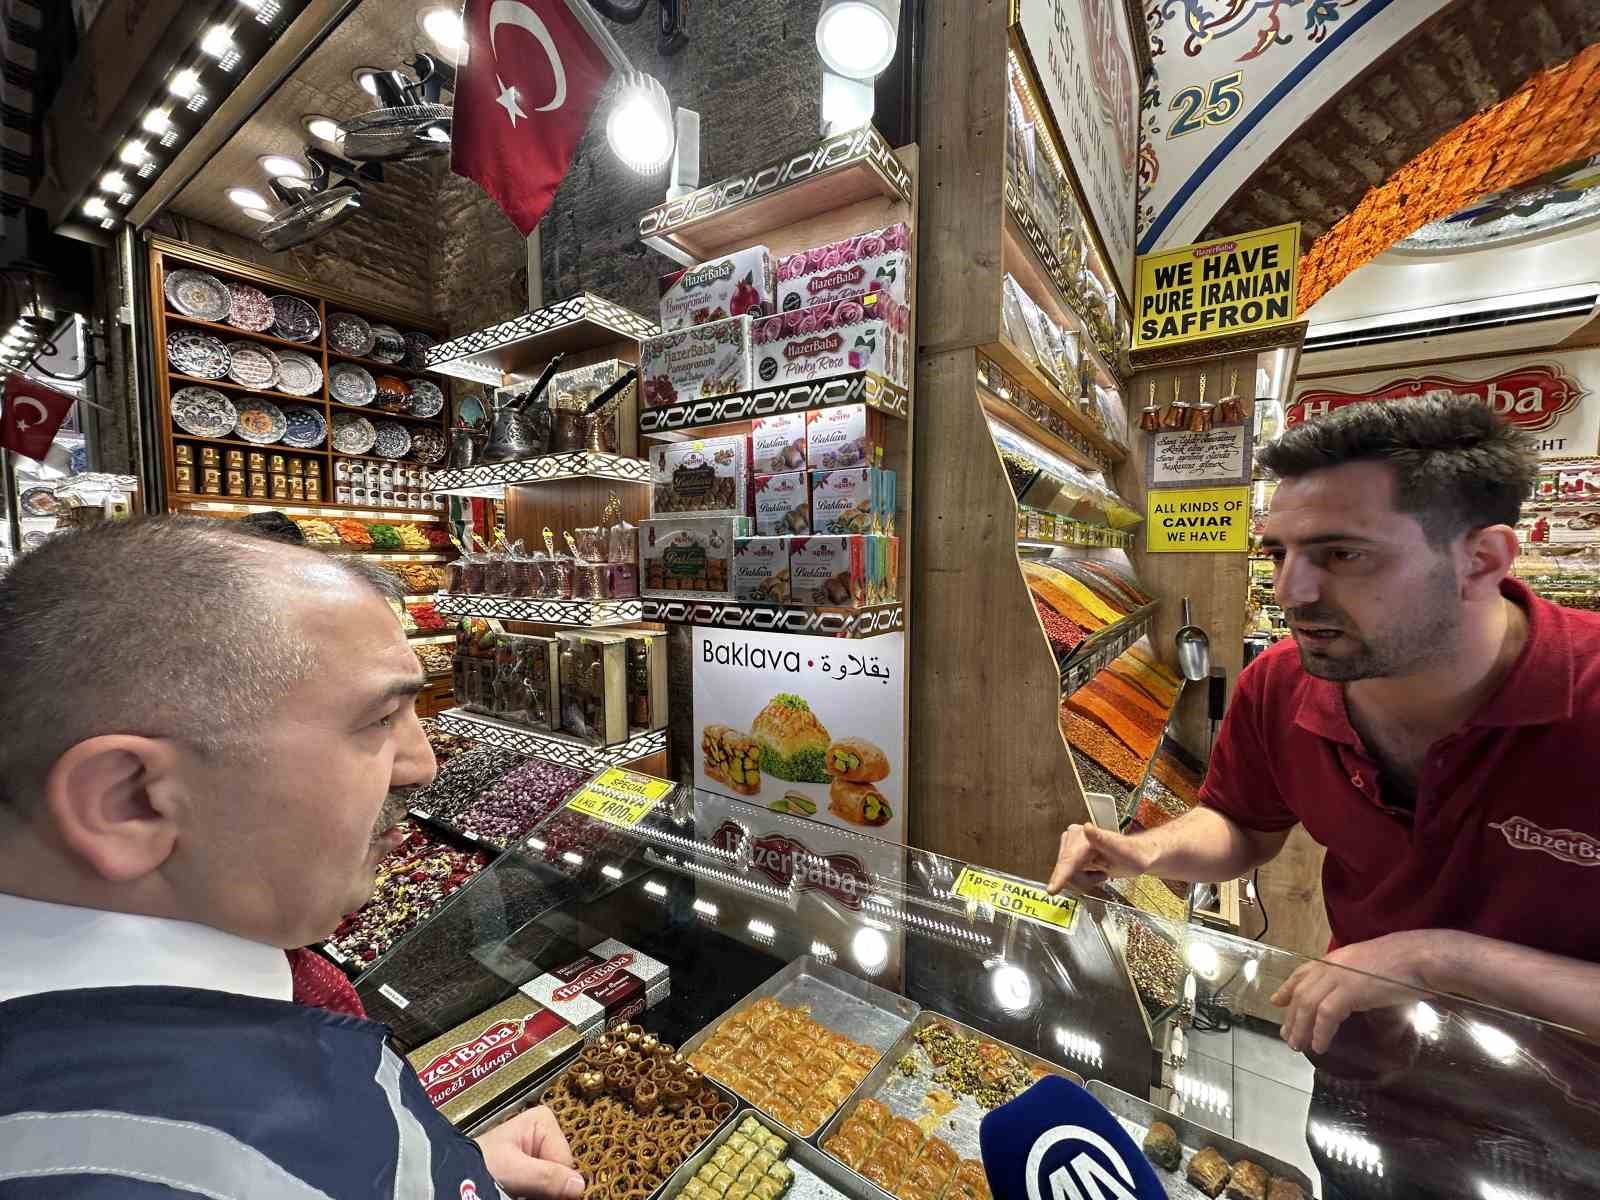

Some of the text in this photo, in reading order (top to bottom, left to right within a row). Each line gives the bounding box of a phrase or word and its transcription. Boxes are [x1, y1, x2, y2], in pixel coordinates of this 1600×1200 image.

[1166, 70, 1244, 141] 25
[685, 266, 729, 287] HazerBaba
[1154, 244, 1279, 290] WE HAVE
[811, 271, 860, 290] HazerBaba
[1143, 269, 1290, 317] PURE IRANIAN
[1141, 296, 1289, 340] SAFFRON
[787, 338, 838, 357] HazerBaba
[783, 361, 817, 379] Pinky
[817, 356, 844, 371] Rose
[1155, 501, 1243, 514] ALL KINDS OF
[1163, 516, 1232, 527] CAVIAR
[1168, 531, 1226, 542] WE HAVE
[703, 640, 800, 673] Baklava
[821, 654, 890, 684] بقلاوة
[611, 778, 647, 794] SPECIAL
[968, 873, 1070, 910] 1pcs BAKLAVA
[557, 956, 629, 998] HazerBaba
